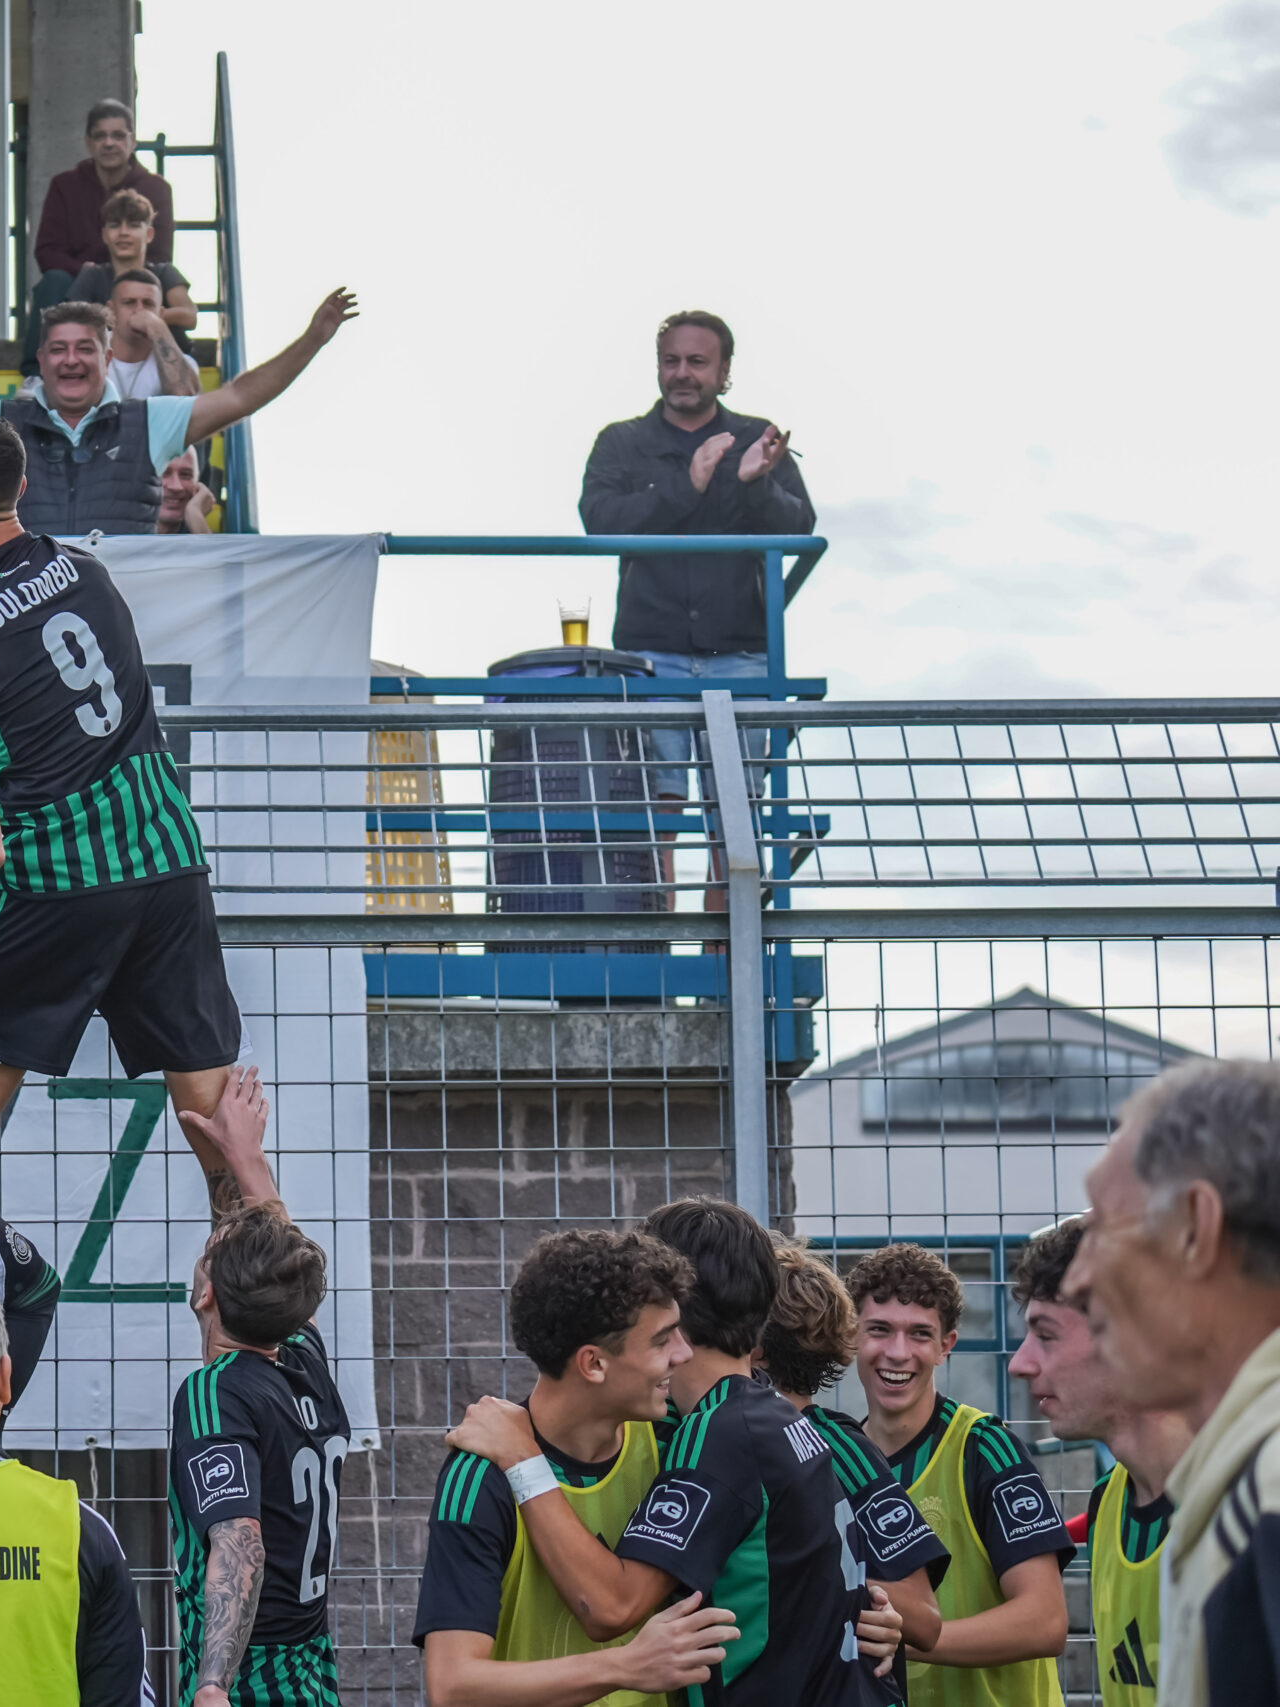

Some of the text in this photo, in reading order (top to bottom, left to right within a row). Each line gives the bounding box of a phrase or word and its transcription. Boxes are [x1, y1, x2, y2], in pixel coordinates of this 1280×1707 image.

[42, 611, 122, 737] 9
[1032, 1518, 1057, 1530] PUMPS
[655, 1529, 684, 1544] PUMPS
[881, 1535, 908, 1556] AFFETTI
